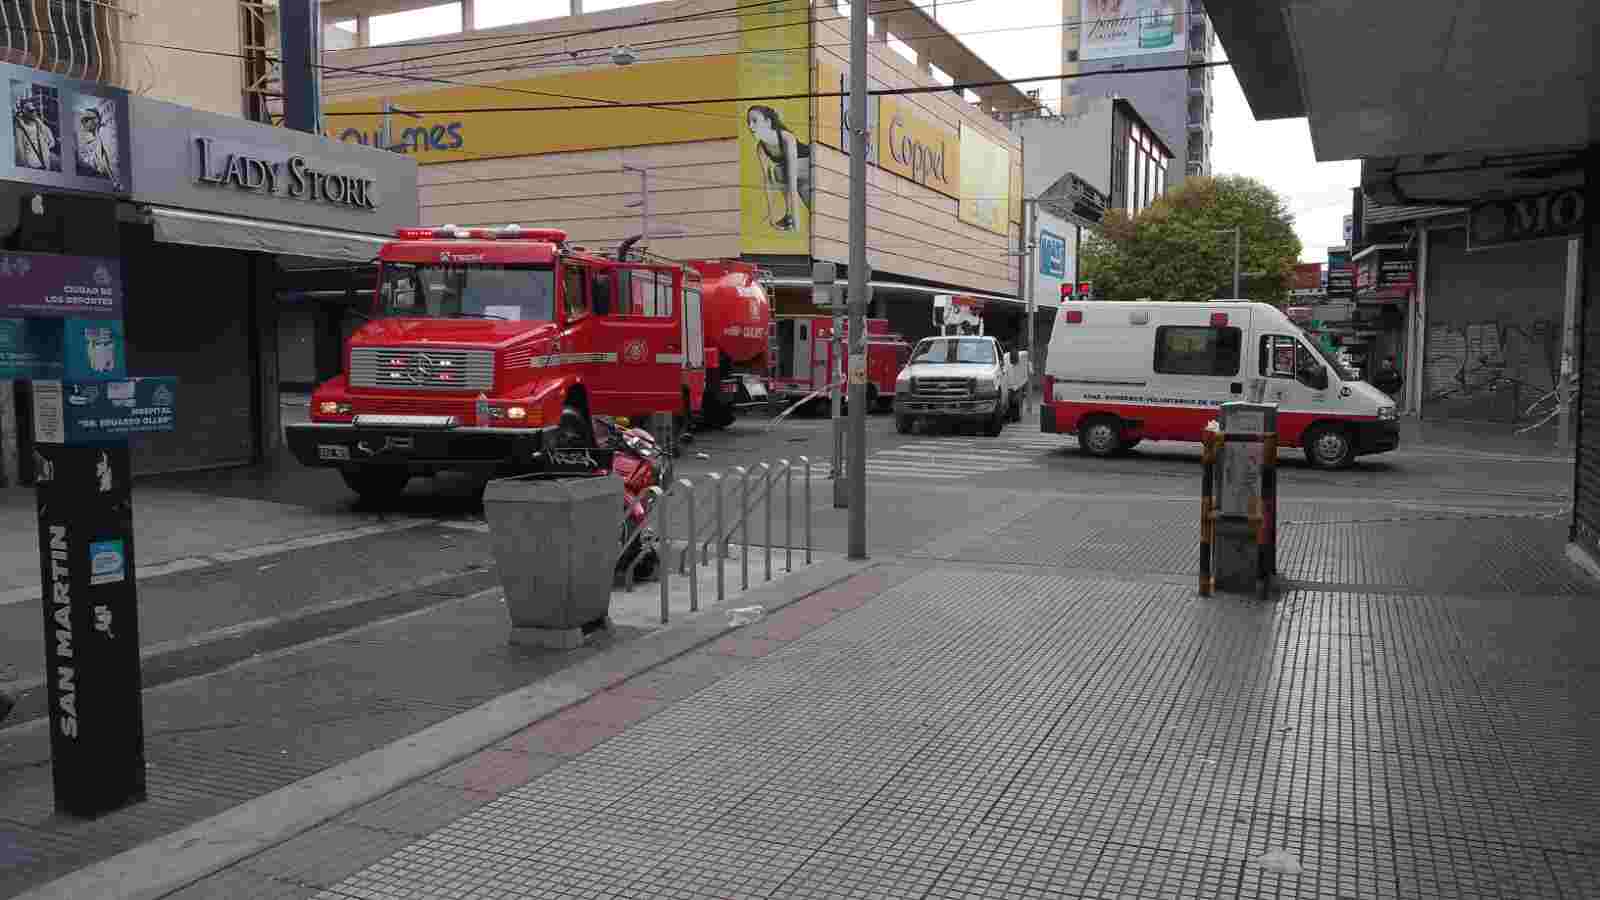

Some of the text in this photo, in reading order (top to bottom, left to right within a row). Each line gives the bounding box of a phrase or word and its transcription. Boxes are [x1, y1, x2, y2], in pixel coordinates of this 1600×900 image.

[194, 136, 377, 211] LADY STORK
[335, 122, 464, 152] uimes
[888, 112, 949, 185] Coppel
[49, 525, 77, 738] SAN MARTIN
